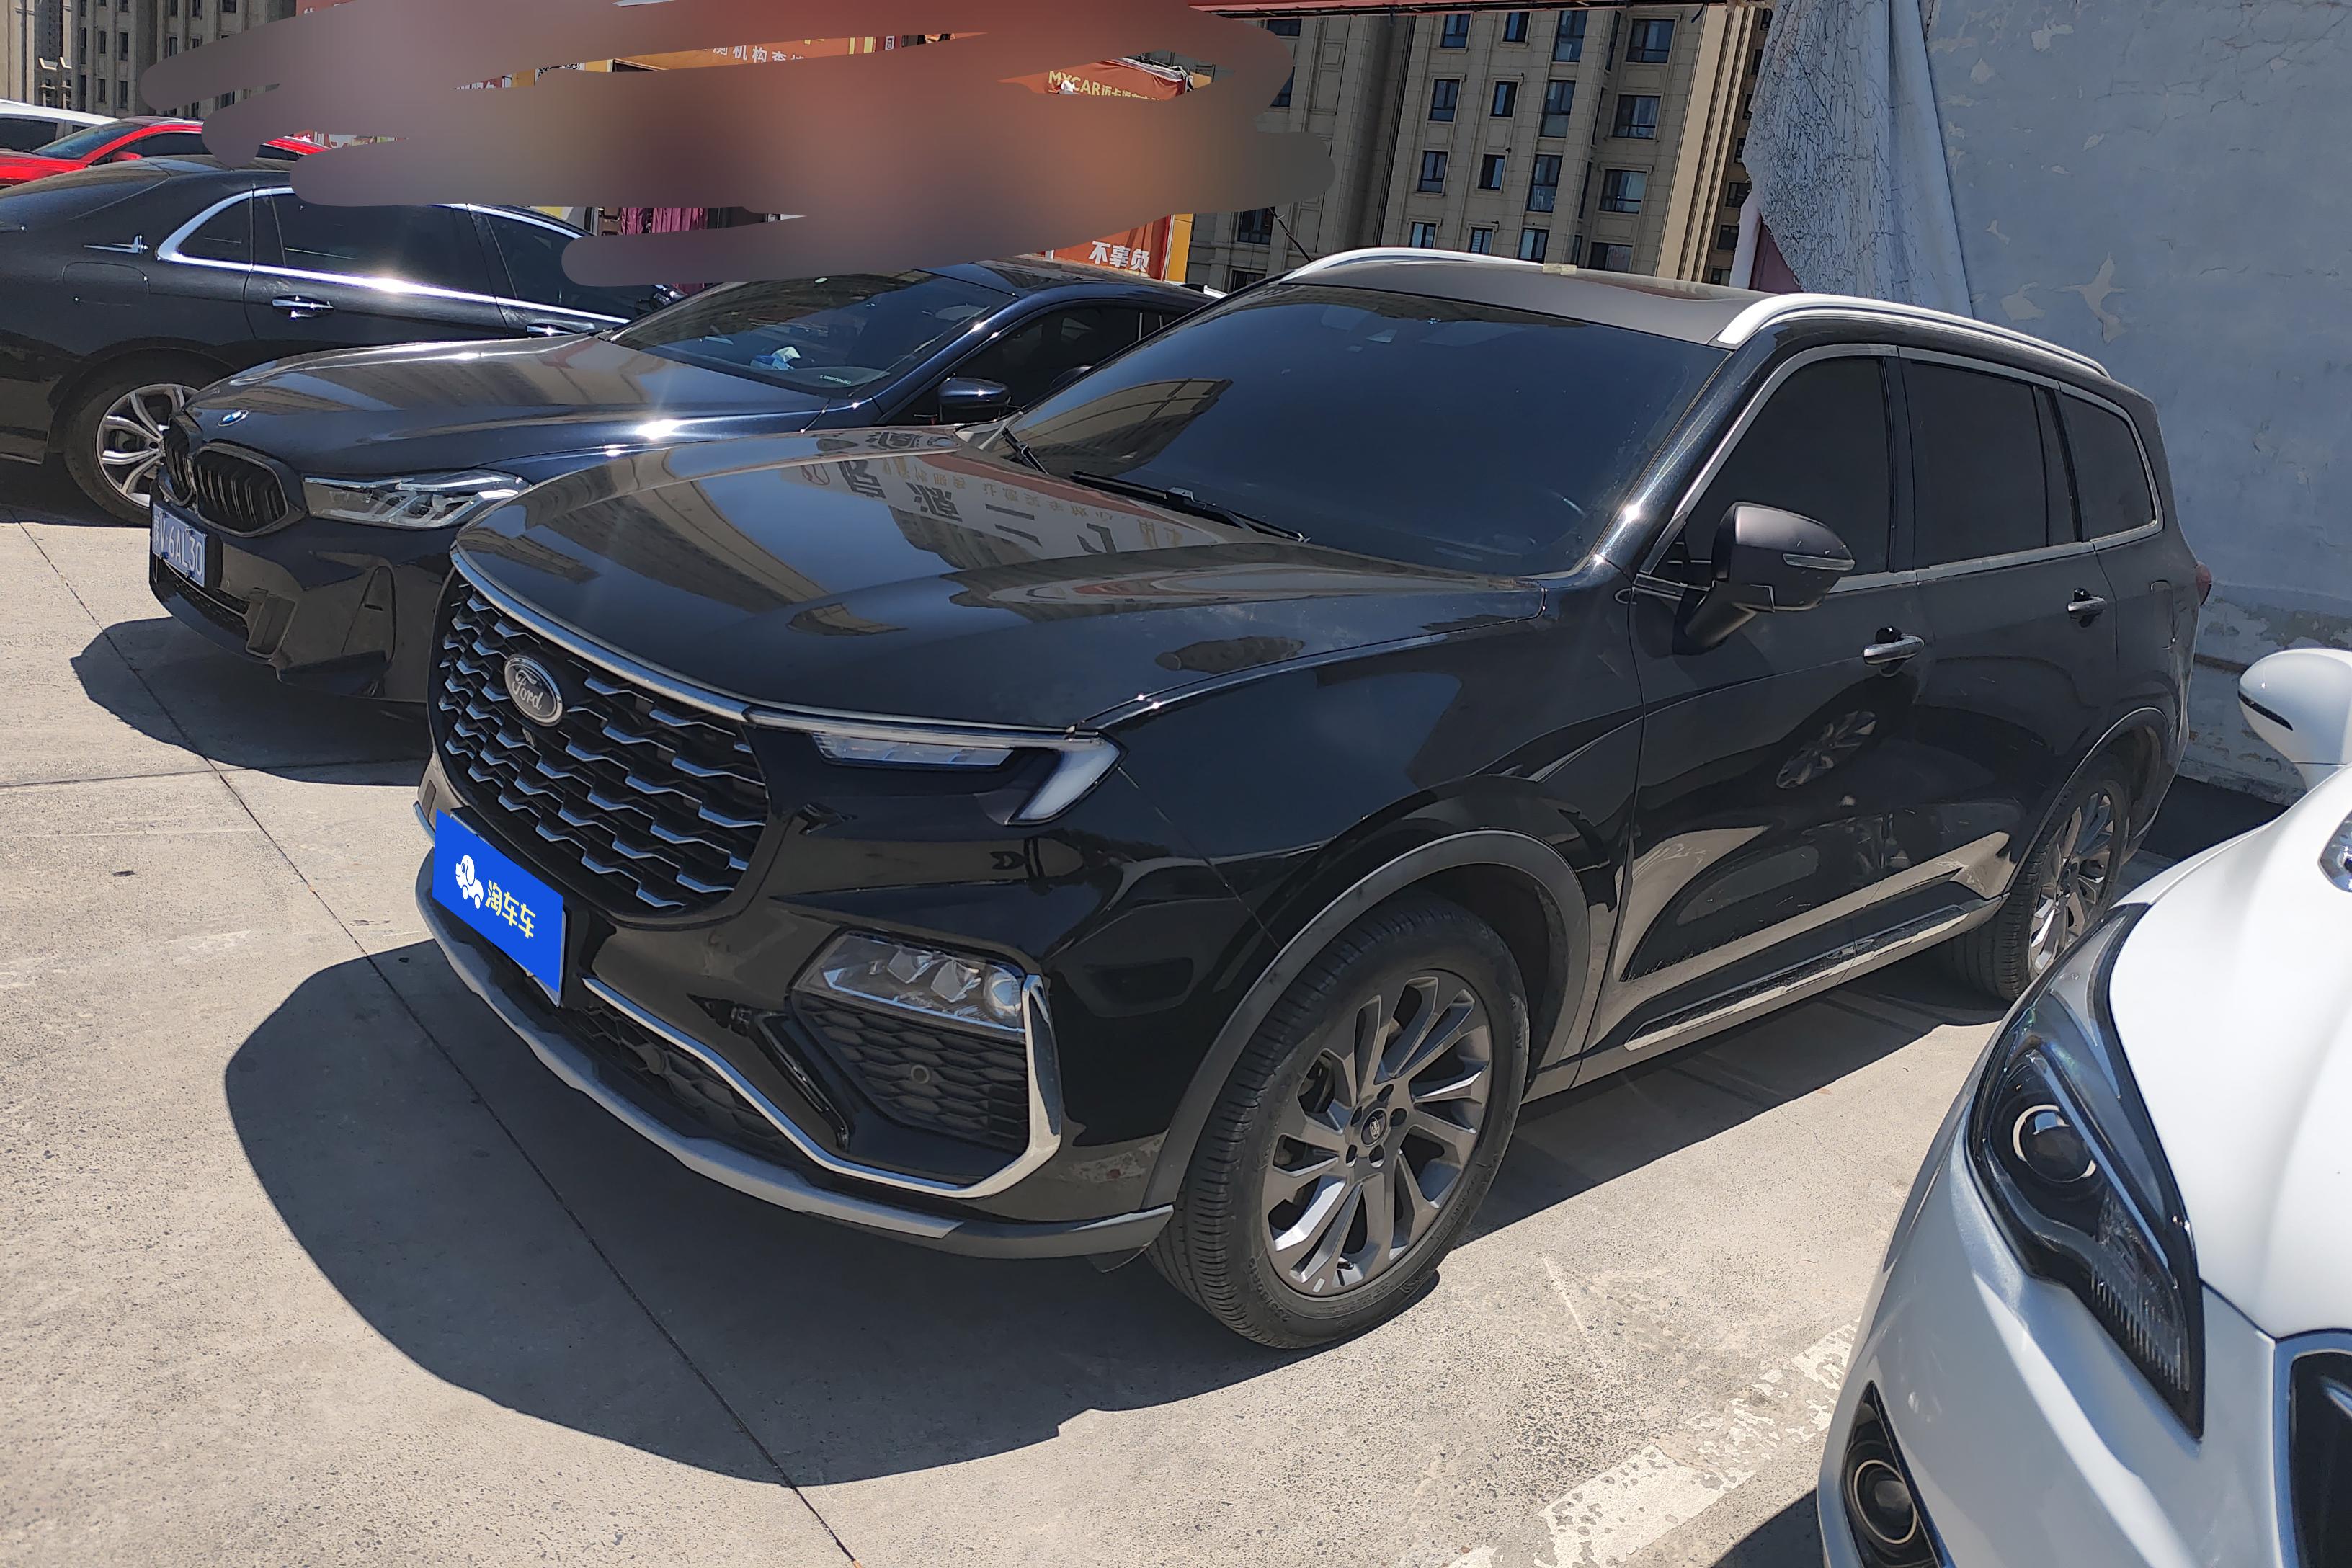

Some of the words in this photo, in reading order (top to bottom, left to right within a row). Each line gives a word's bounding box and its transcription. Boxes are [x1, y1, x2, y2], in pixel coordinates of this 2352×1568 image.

[1088, 241, 1149, 272] 不辜负
[511, 669, 544, 710] Ford
